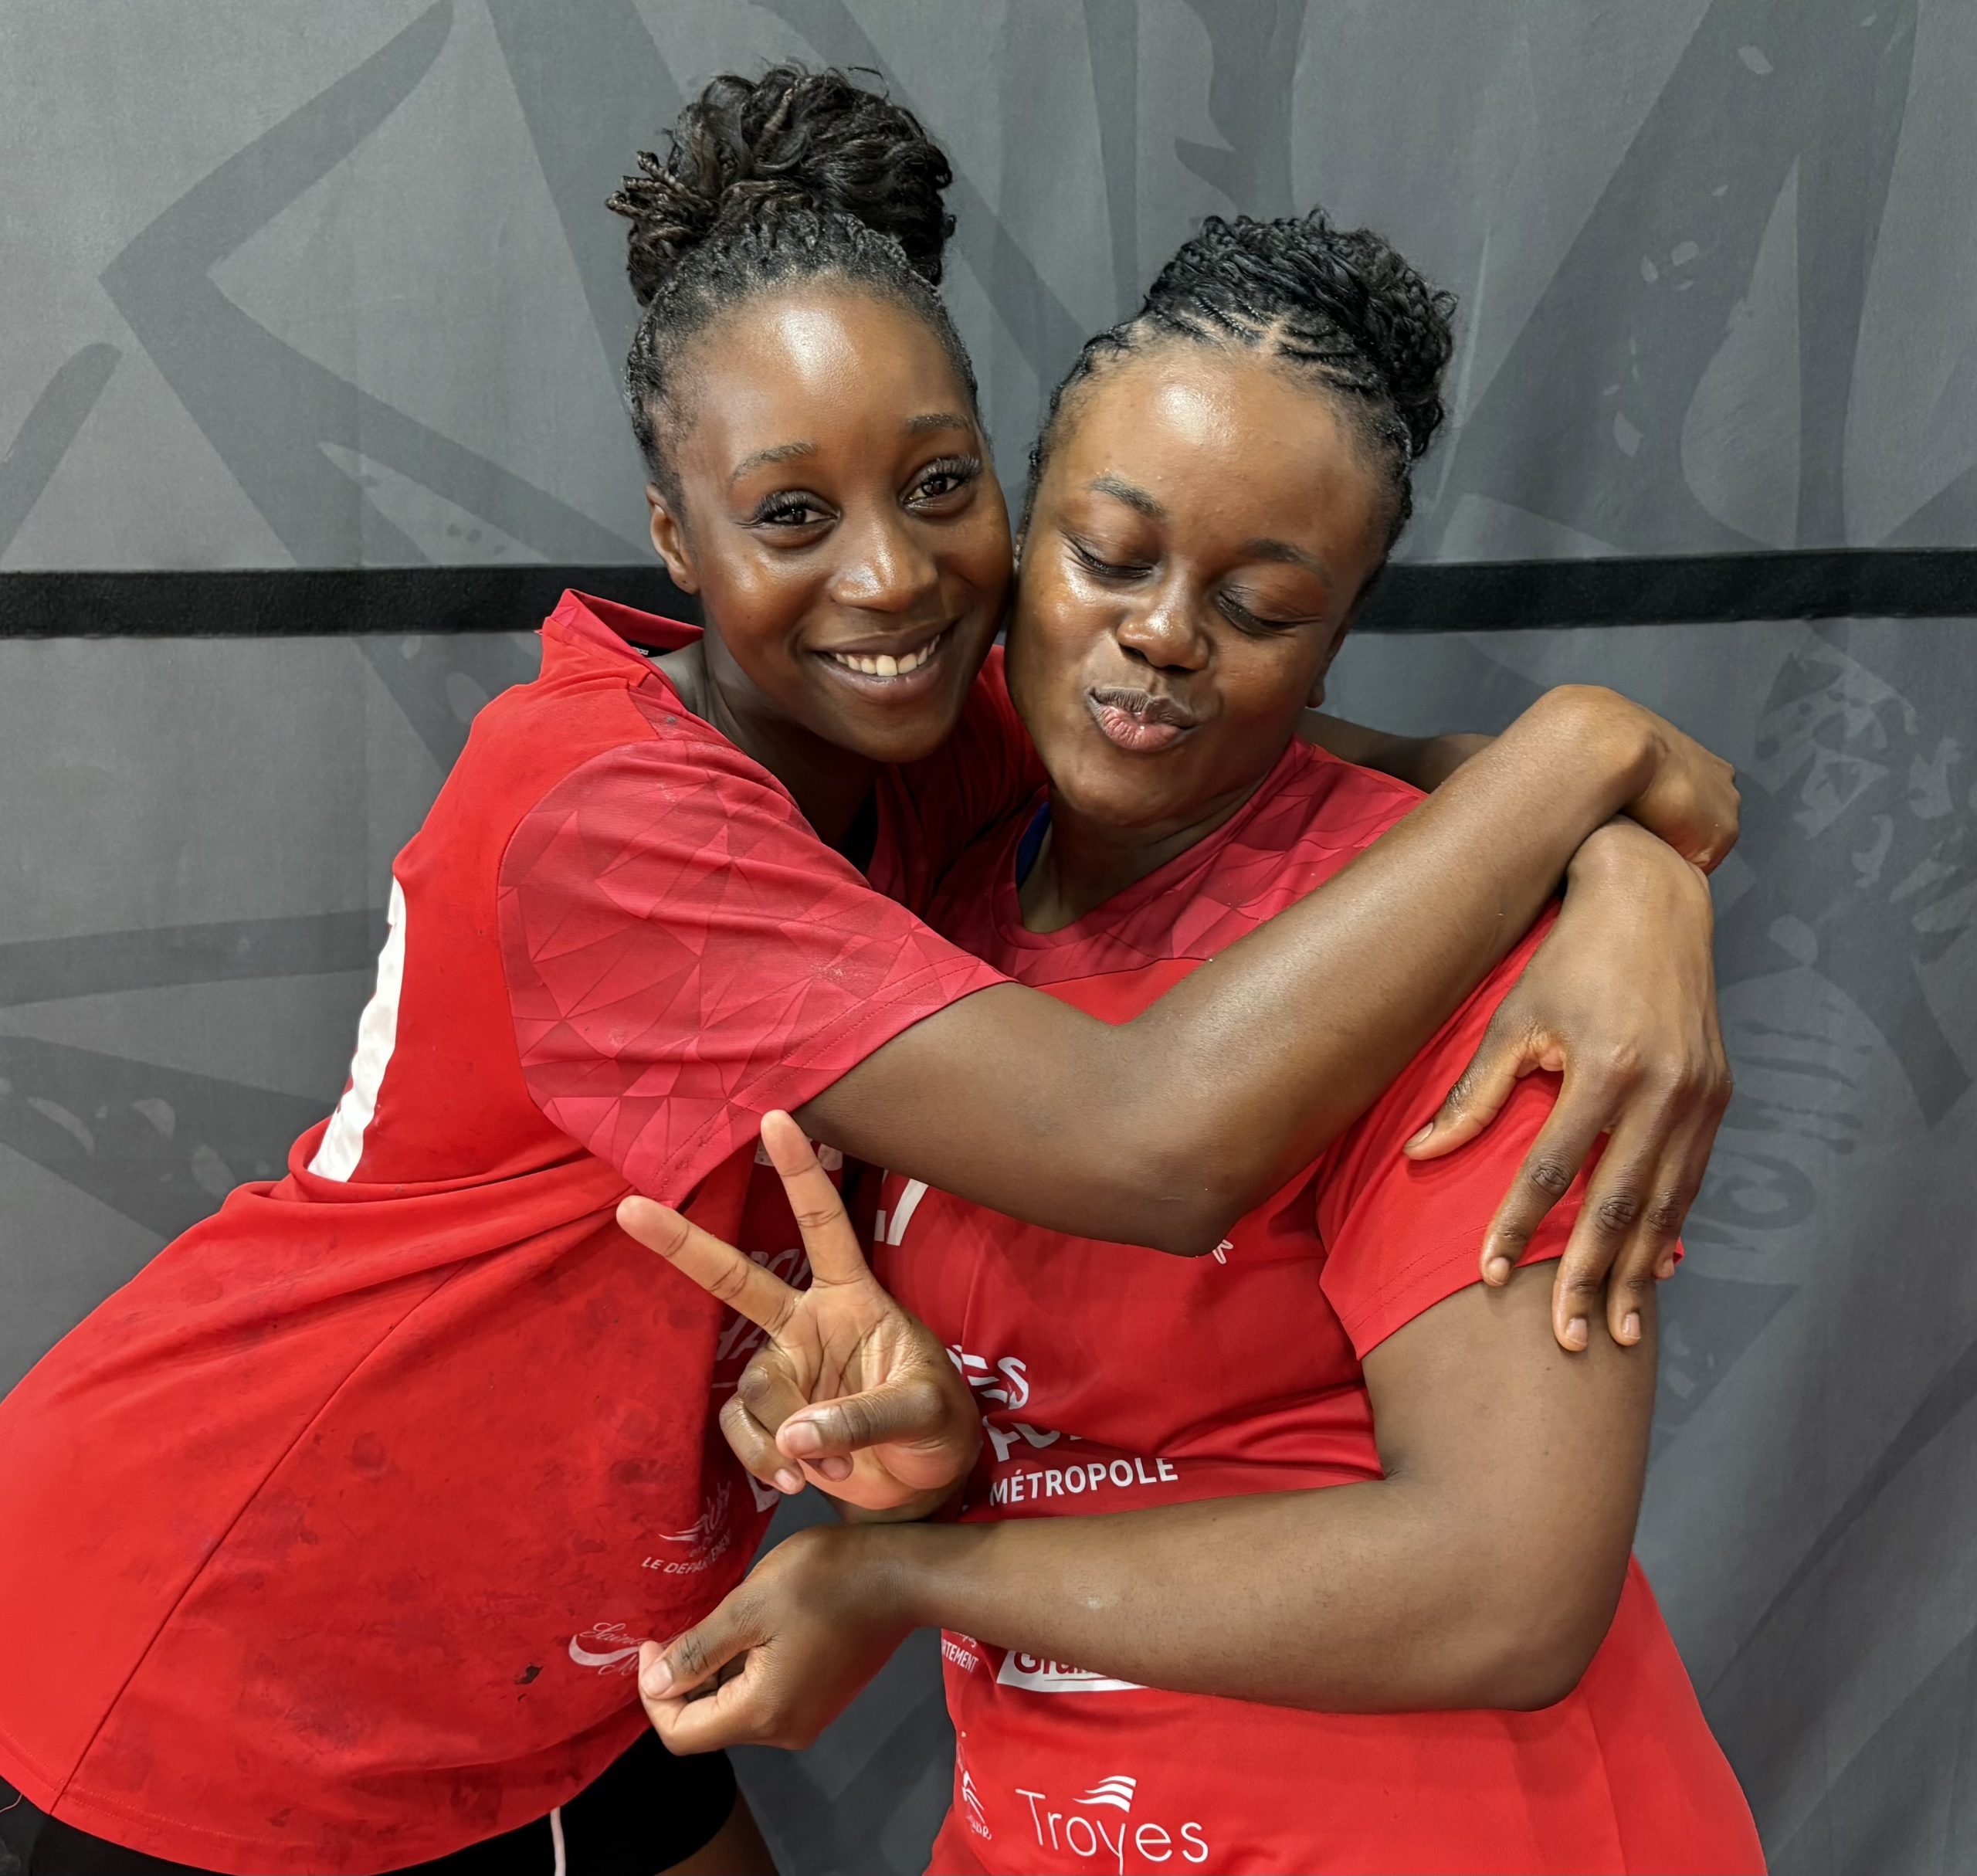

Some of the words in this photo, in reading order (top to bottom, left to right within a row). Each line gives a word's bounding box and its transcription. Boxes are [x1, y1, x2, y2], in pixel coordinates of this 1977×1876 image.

[989, 1457, 1178, 1506] MÉTROPOLE
[641, 1556, 664, 1569] LE
[1015, 1788, 1209, 1876] Troyes
